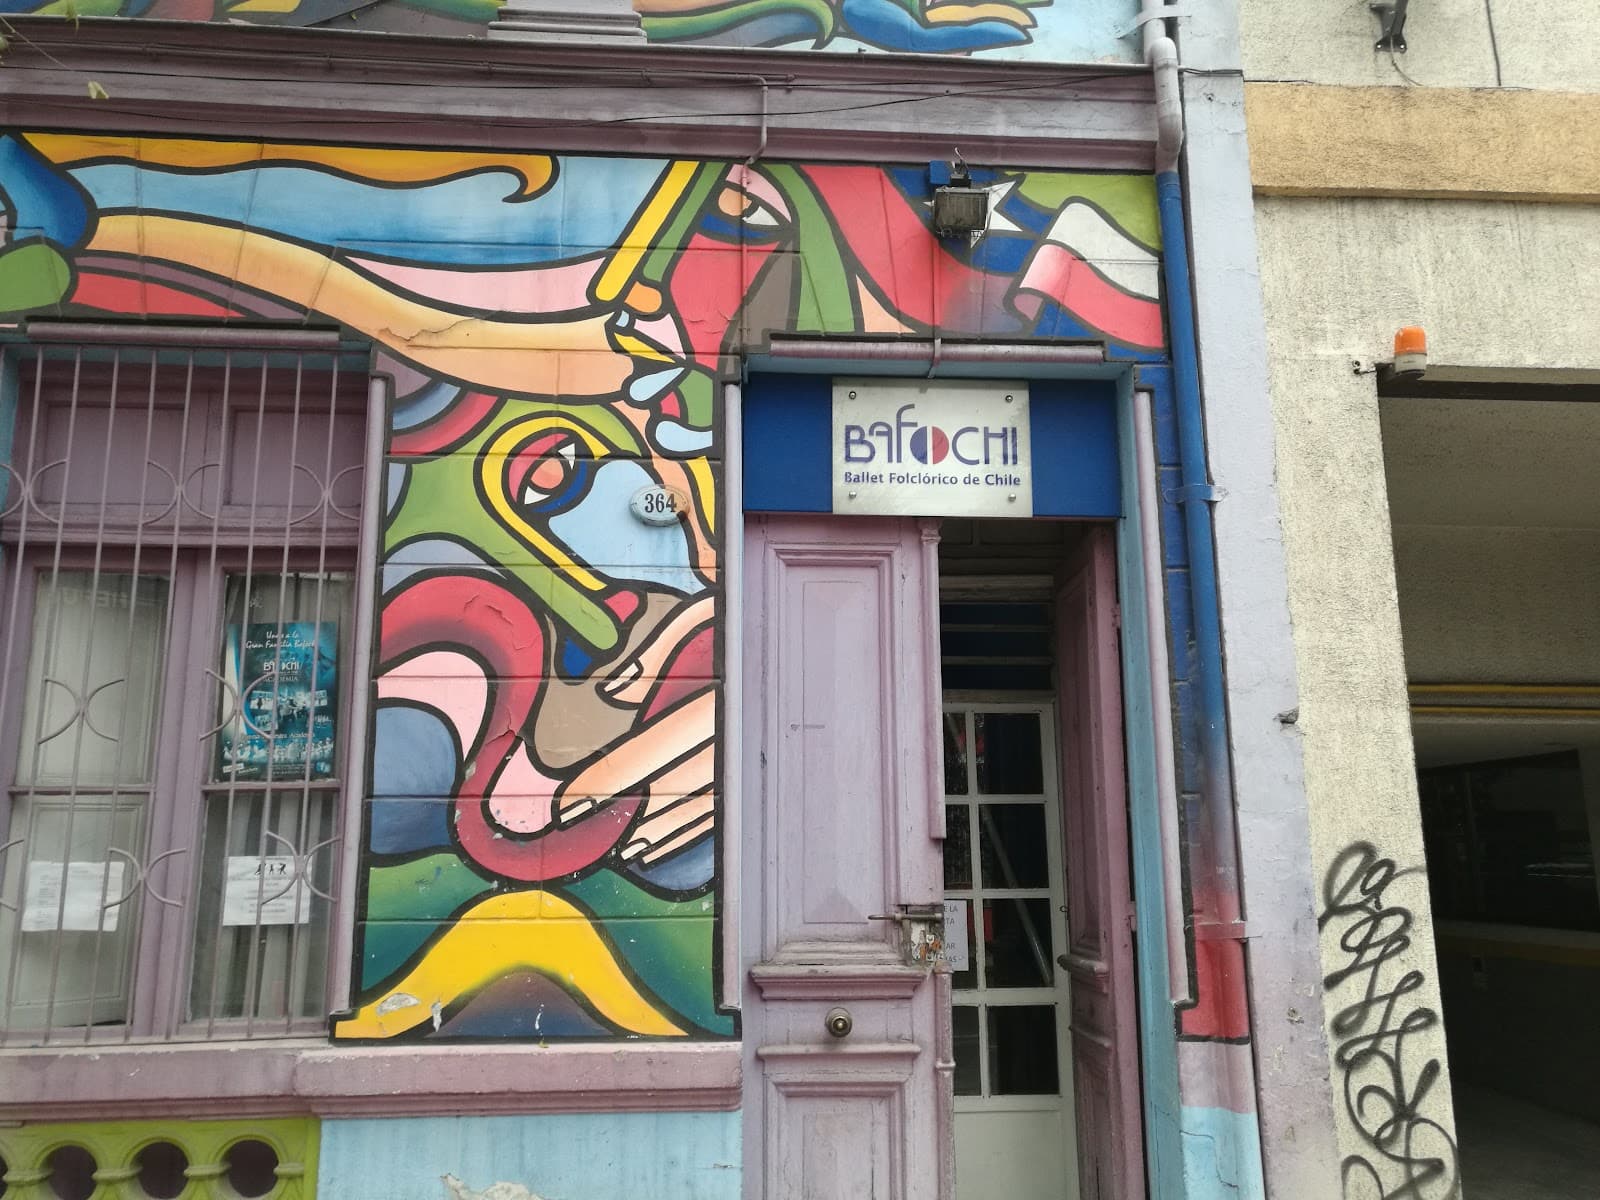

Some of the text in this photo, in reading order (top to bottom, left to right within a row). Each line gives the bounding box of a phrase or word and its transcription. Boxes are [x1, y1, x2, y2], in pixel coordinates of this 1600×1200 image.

[844, 403, 1018, 466] BAFOCHI
[844, 471, 1021, 486] Ballet Folclórico de Chile
[644, 492, 678, 513] 364
[265, 639, 292, 649] Famlia
